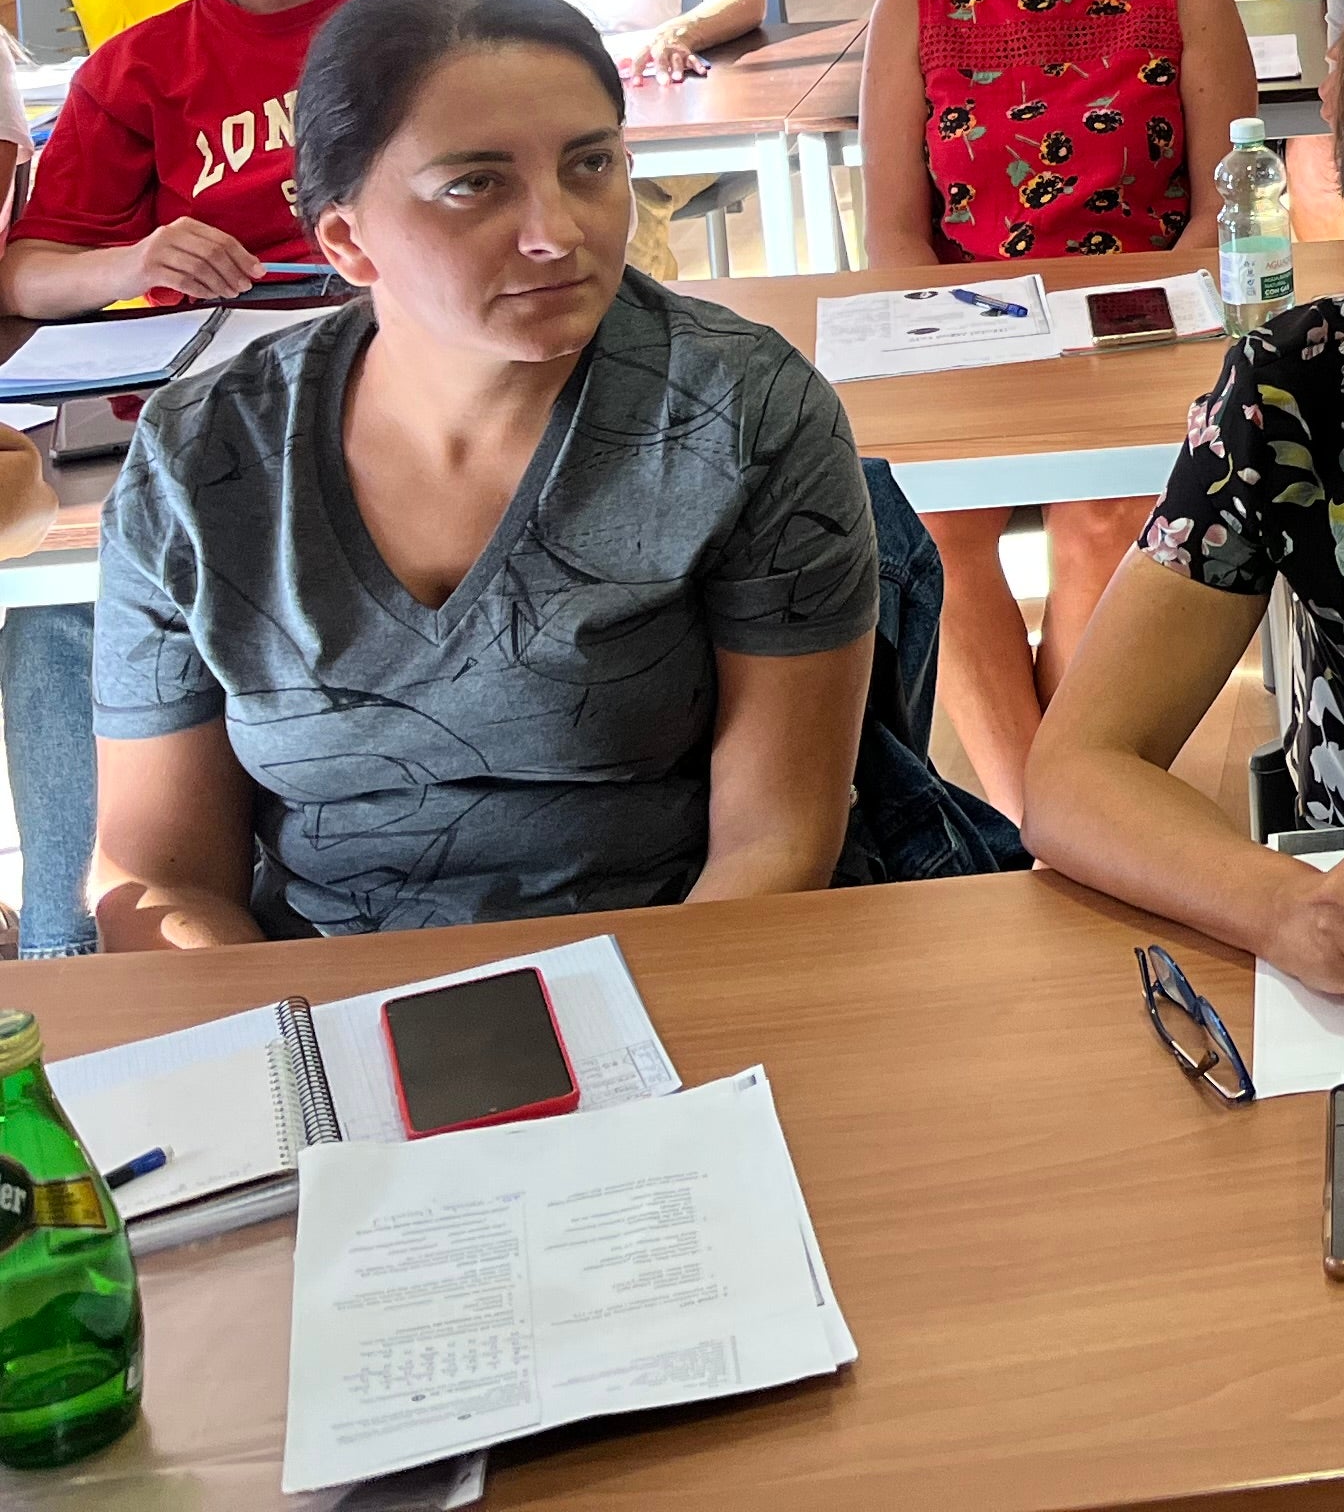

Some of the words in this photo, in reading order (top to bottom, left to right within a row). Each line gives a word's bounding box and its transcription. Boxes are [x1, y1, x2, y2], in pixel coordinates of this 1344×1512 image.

[192, 89, 298, 198] LON
[1264, 287, 1279, 296] CON
[0, 1181, 28, 1216] er
